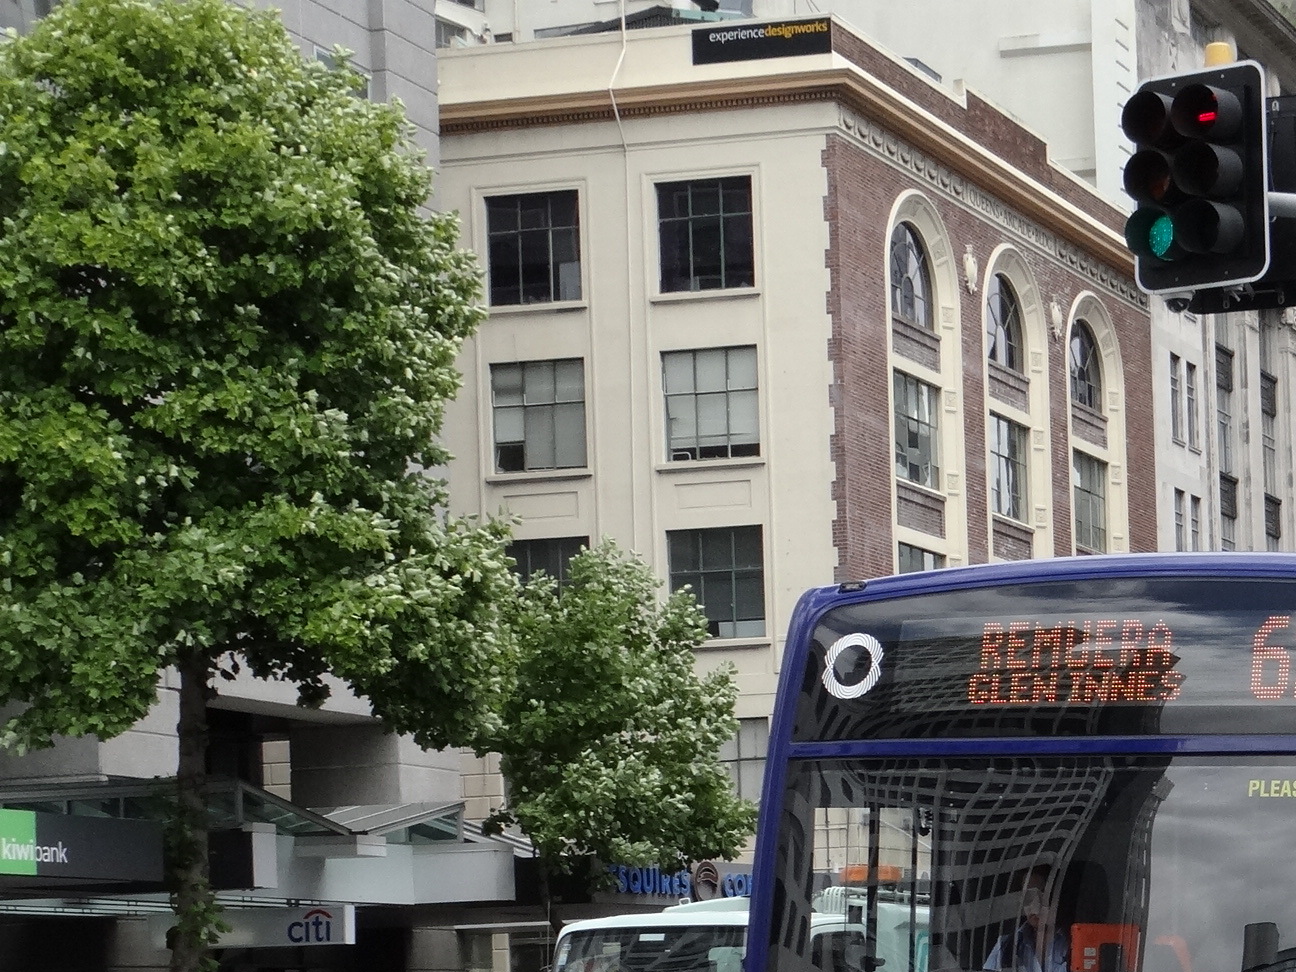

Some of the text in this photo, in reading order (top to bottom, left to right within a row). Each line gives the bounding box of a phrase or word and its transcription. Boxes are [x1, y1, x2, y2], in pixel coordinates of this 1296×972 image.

[980, 619, 1172, 669] REMUERA
[968, 670, 1182, 703] GLEN INNES
[1, 837, 68, 863] kiwibank
[610, 865, 691, 895] SQUIRES
[287, 911, 332, 943] citi
